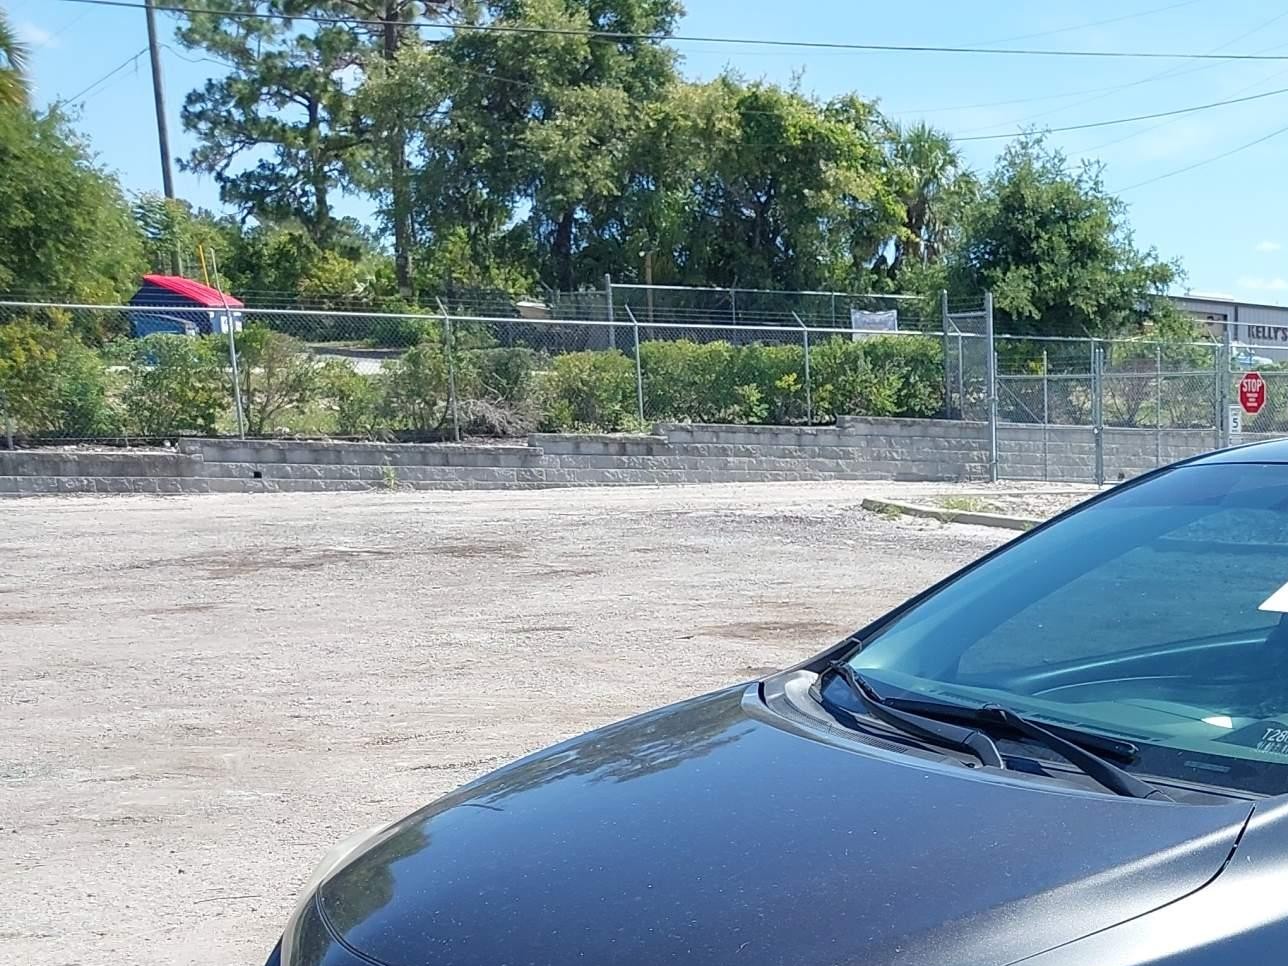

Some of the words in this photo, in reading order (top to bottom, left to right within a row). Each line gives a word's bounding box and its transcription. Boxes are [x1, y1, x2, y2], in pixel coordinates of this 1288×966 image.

[1247, 324, 1288, 342] KELLY'S
[1242, 379, 1262, 393] STOP
[1232, 418, 1239, 428] 5
